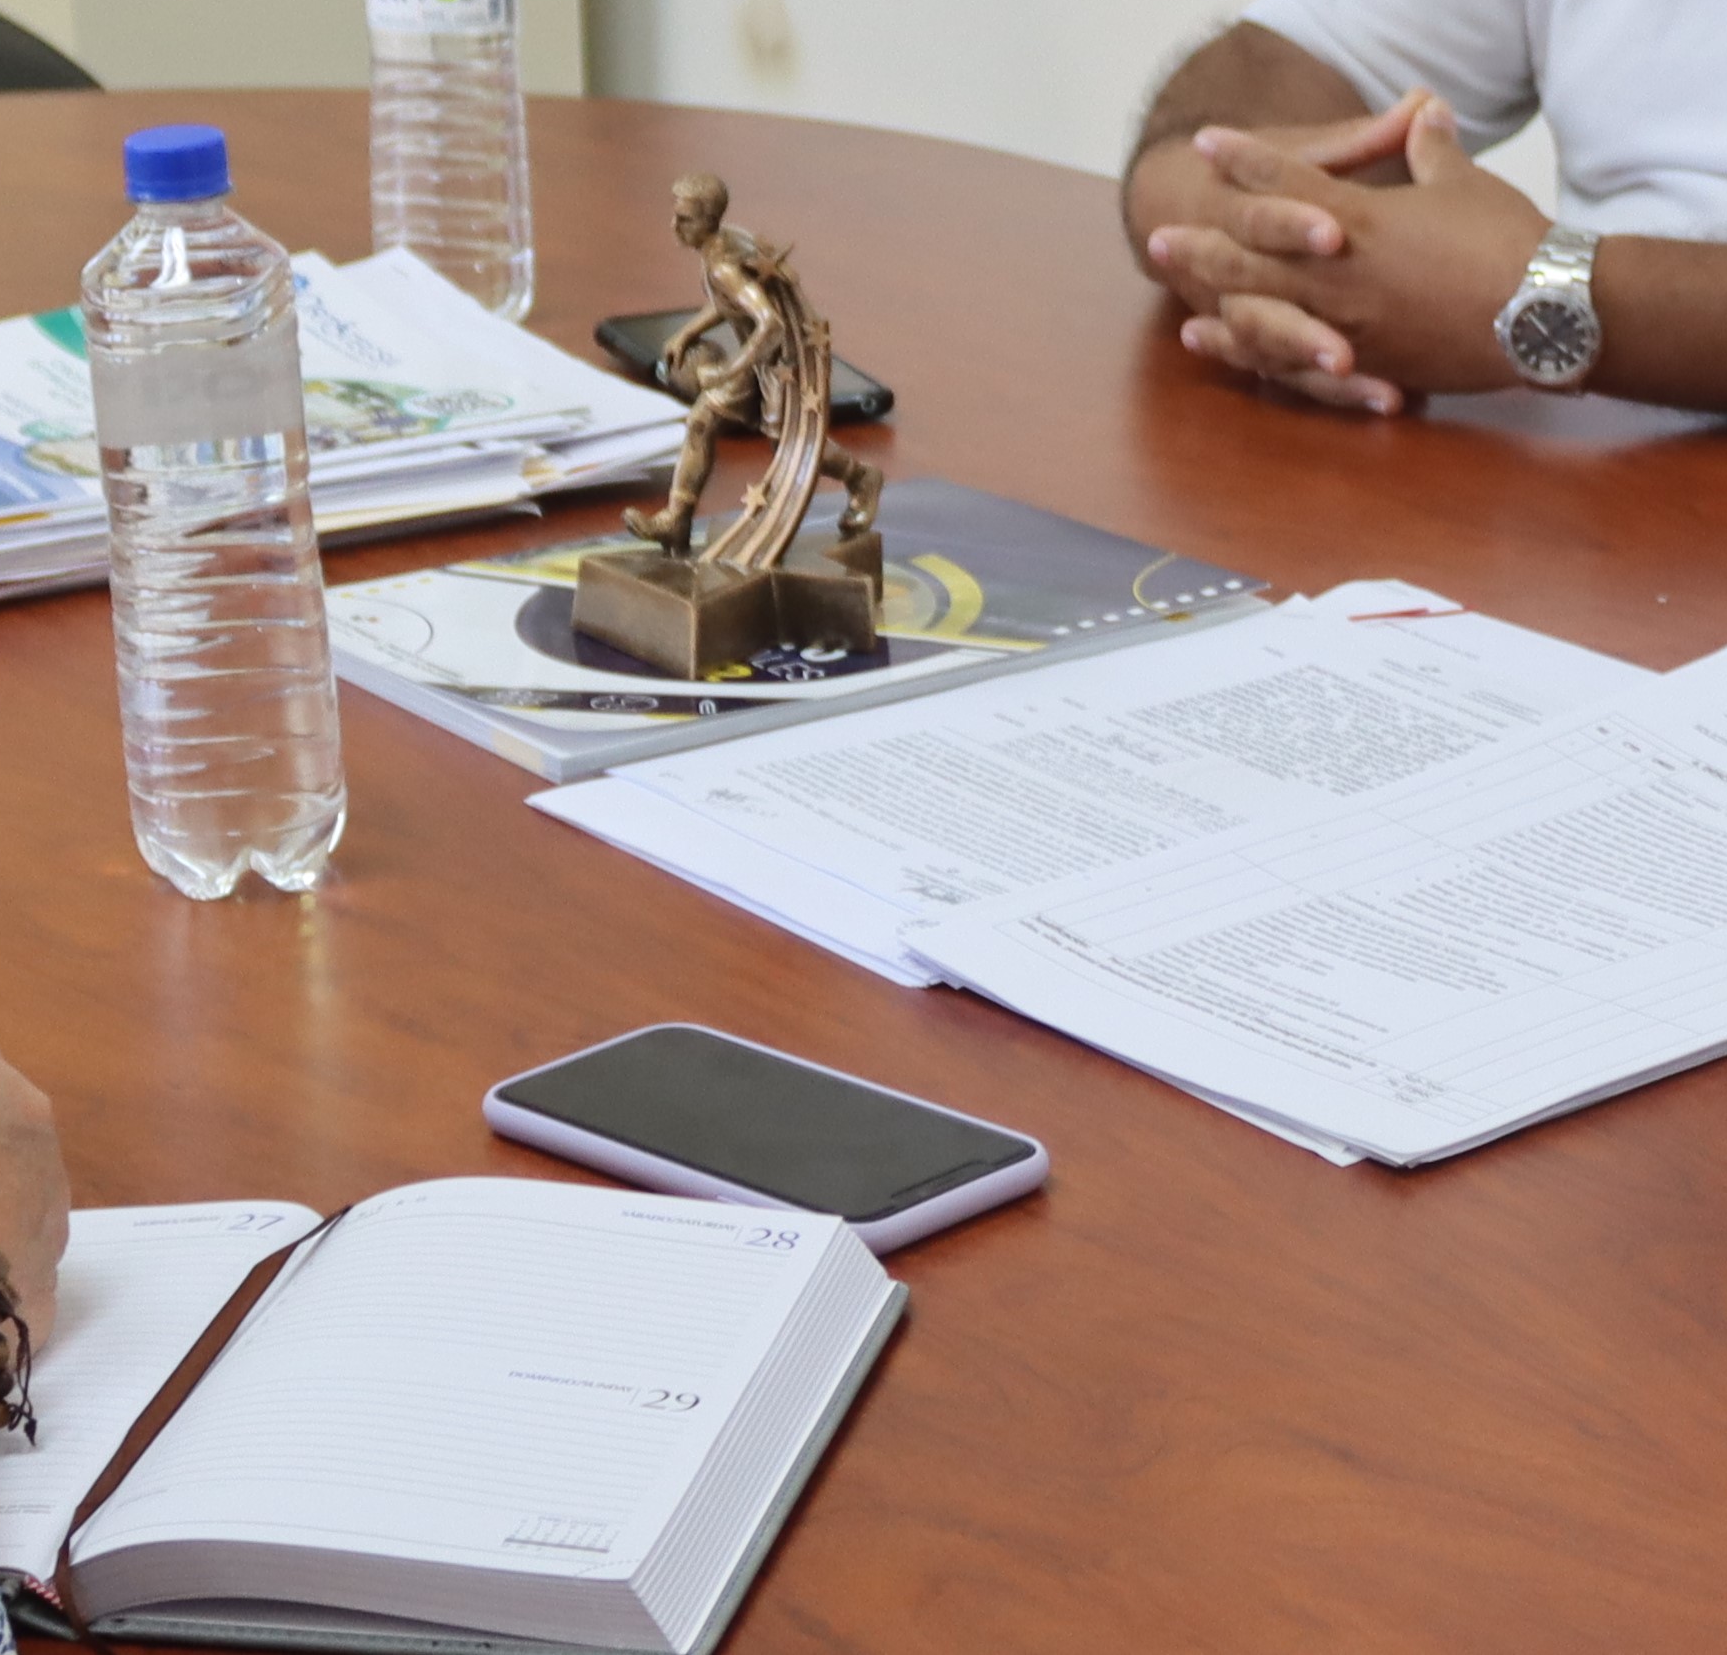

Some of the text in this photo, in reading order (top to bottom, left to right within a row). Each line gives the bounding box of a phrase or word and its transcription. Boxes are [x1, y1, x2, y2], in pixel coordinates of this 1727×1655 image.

[228, 1213, 285, 1231] 27
[744, 1227, 800, 1251] 28
[642, 1388, 701, 1413] 29
